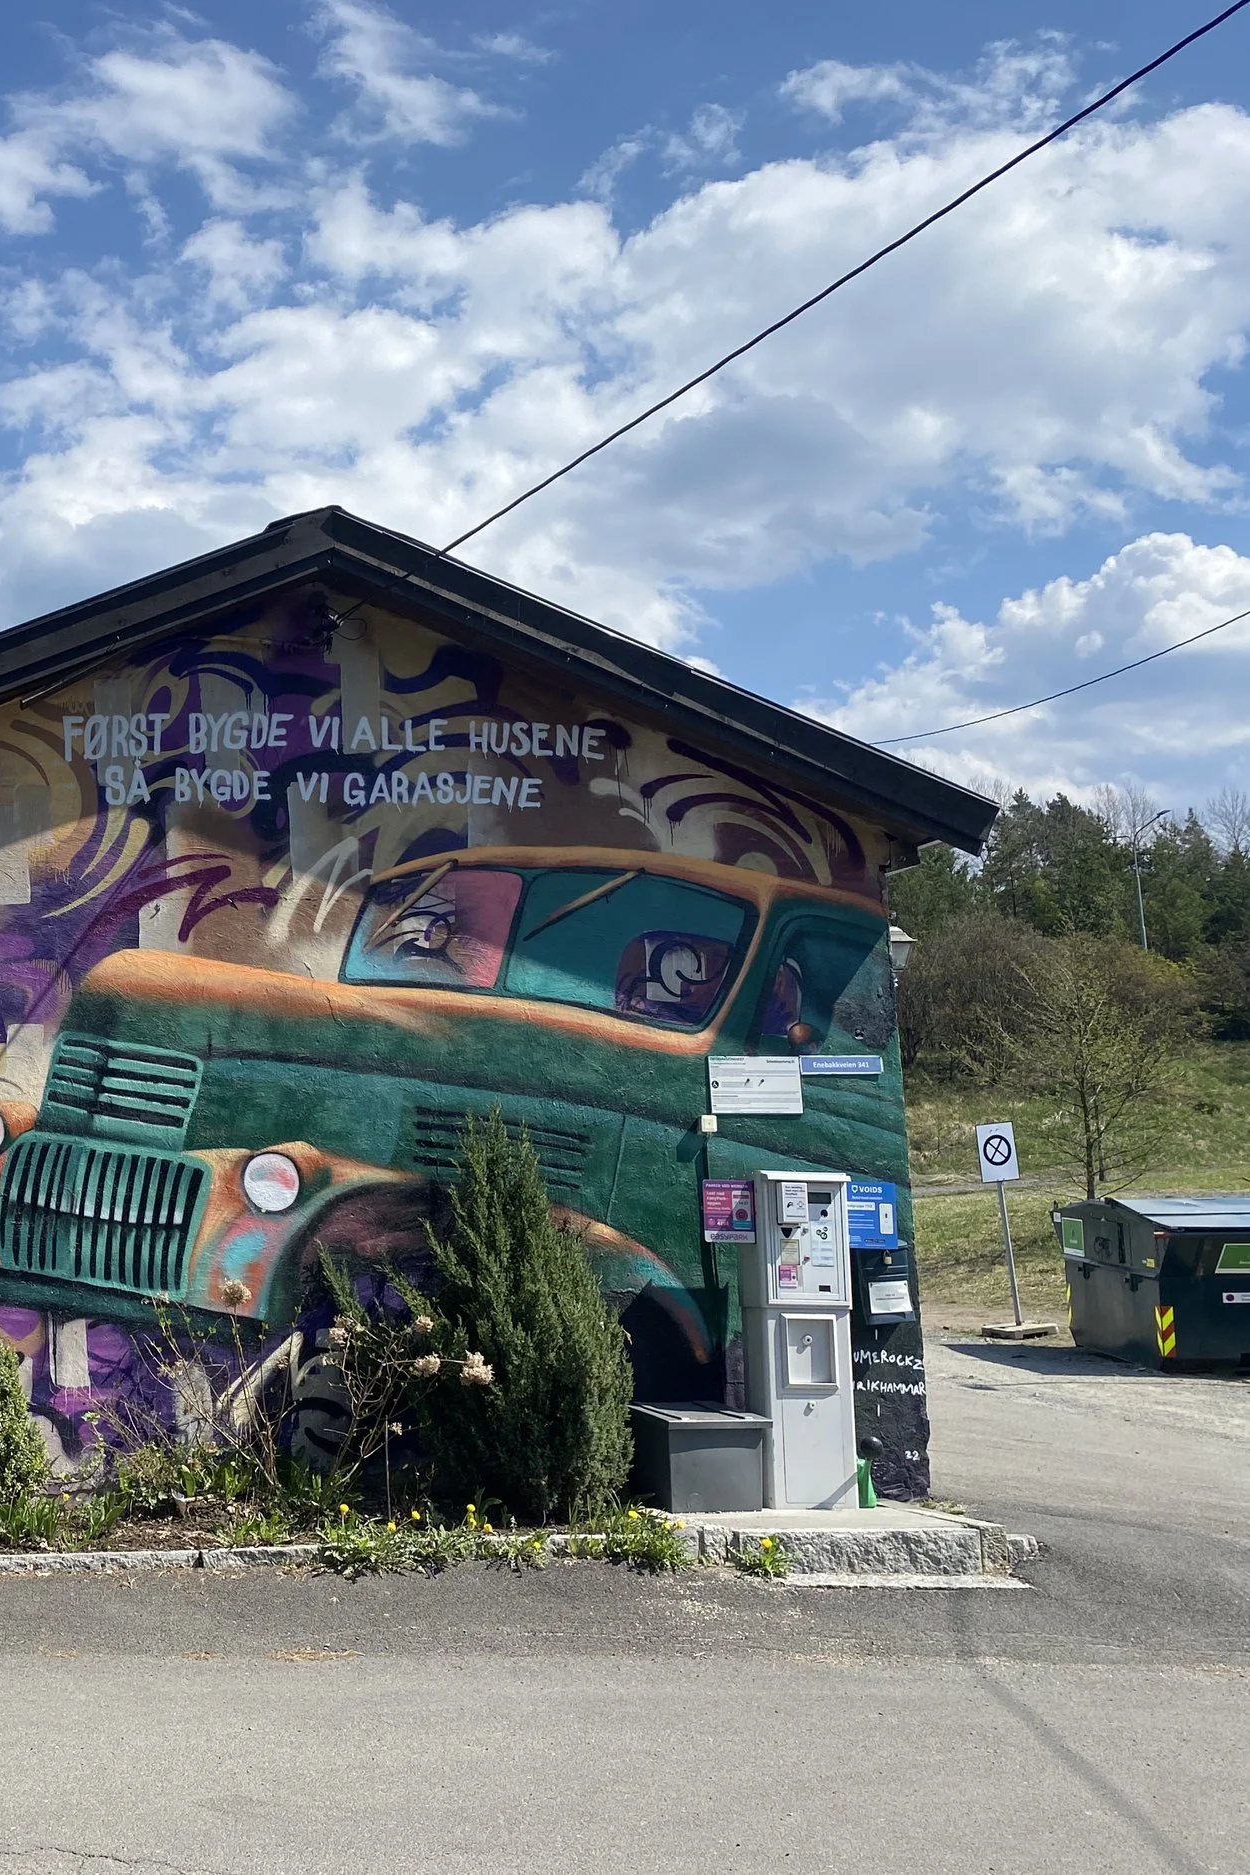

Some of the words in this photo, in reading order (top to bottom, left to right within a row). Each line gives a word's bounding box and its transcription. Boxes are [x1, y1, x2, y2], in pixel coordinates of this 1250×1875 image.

[62, 713, 170, 762] FØRST
[188, 711, 294, 754] BYGDE
[308, 714, 340, 755] VI
[350, 715, 448, 752] ALLE
[469, 719, 607, 764] HUSENE
[174, 767, 272, 806] BYGDE
[296, 771, 329, 803] VI
[343, 771, 543, 811] GARASJENE
[905, 1450, 920, 1461] 22
